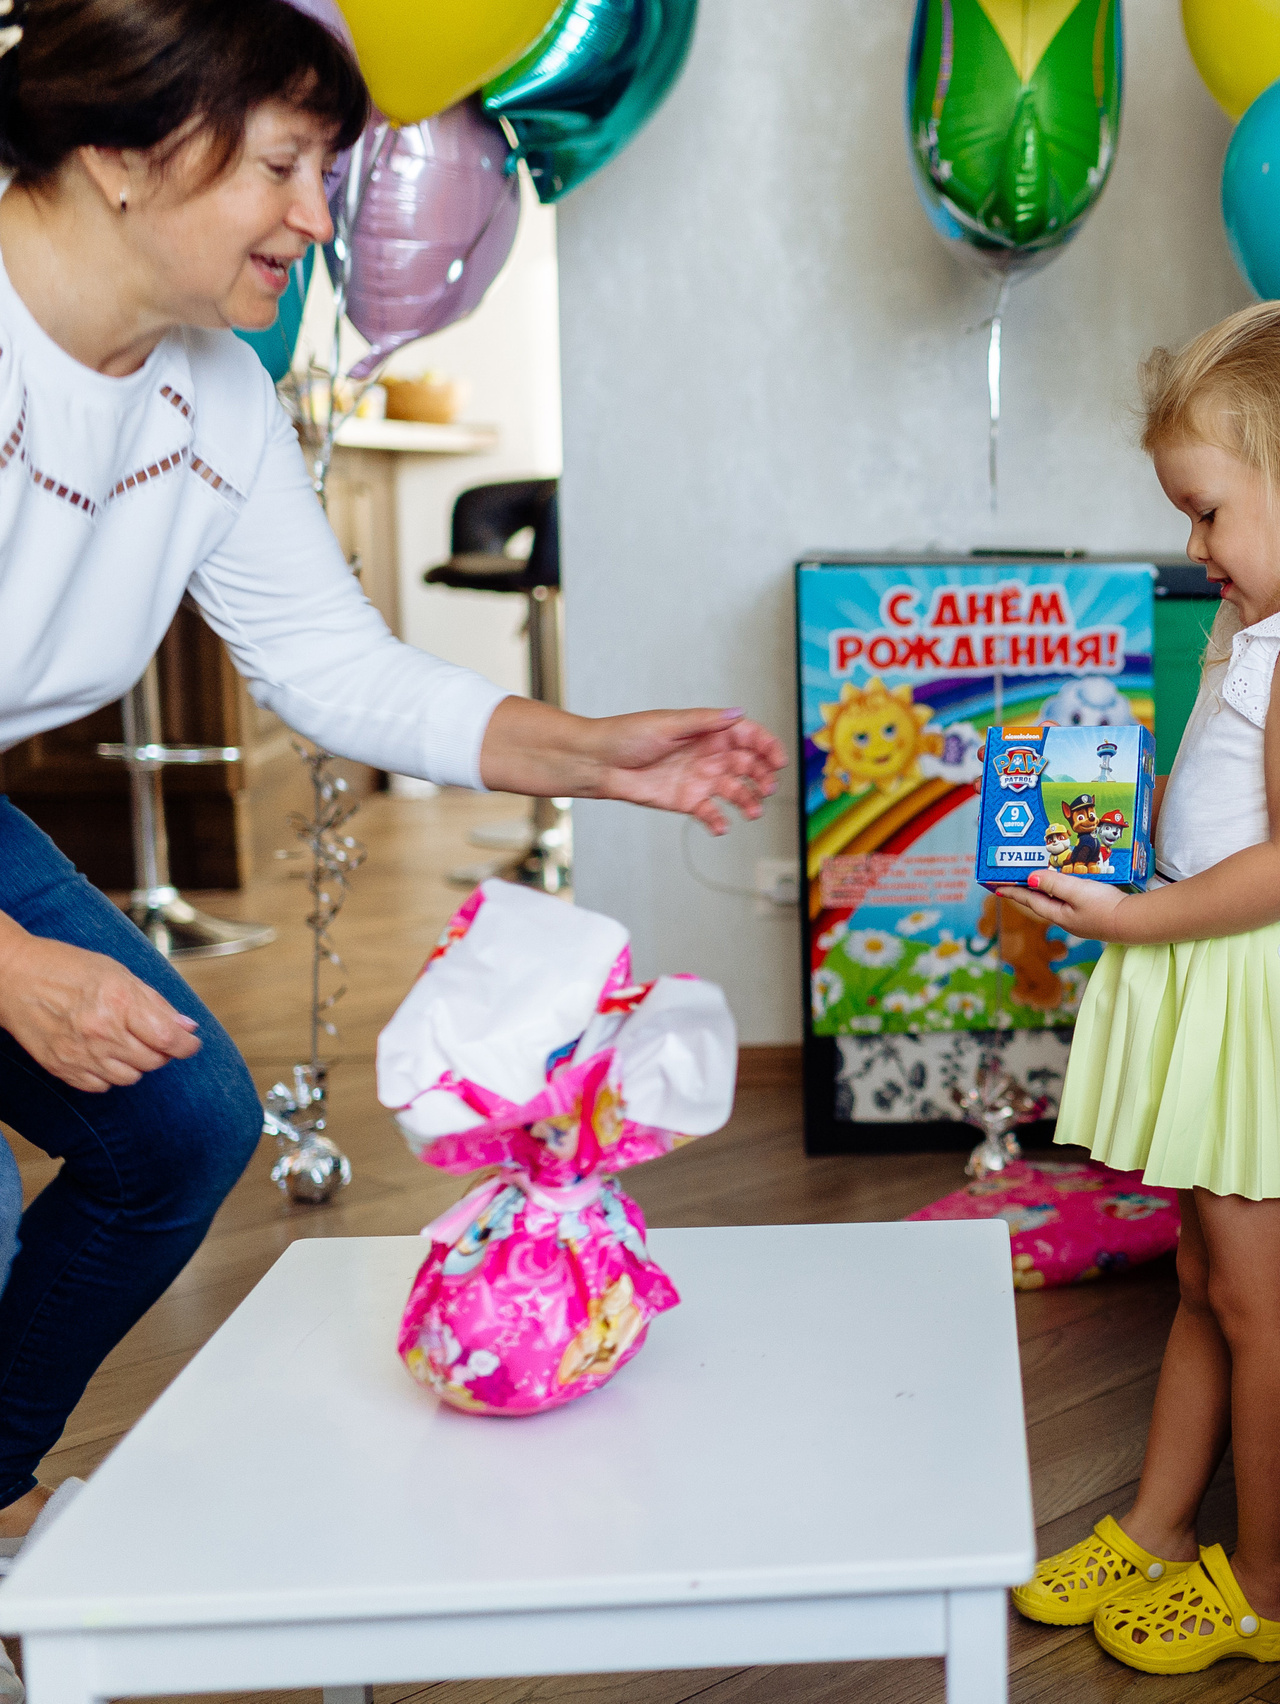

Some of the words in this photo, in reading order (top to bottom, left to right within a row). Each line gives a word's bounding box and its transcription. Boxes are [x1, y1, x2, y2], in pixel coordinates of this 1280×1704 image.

[887, 592, 913, 626] С
[933, 587, 1066, 627] ДНЁМ
[837, 633, 1119, 670] РОЖДЕНИЯ!
[993, 753, 1048, 776] PAW
[1011, 807, 1020, 821] 9
[1000, 851, 1045, 861] ГУАШЬ
